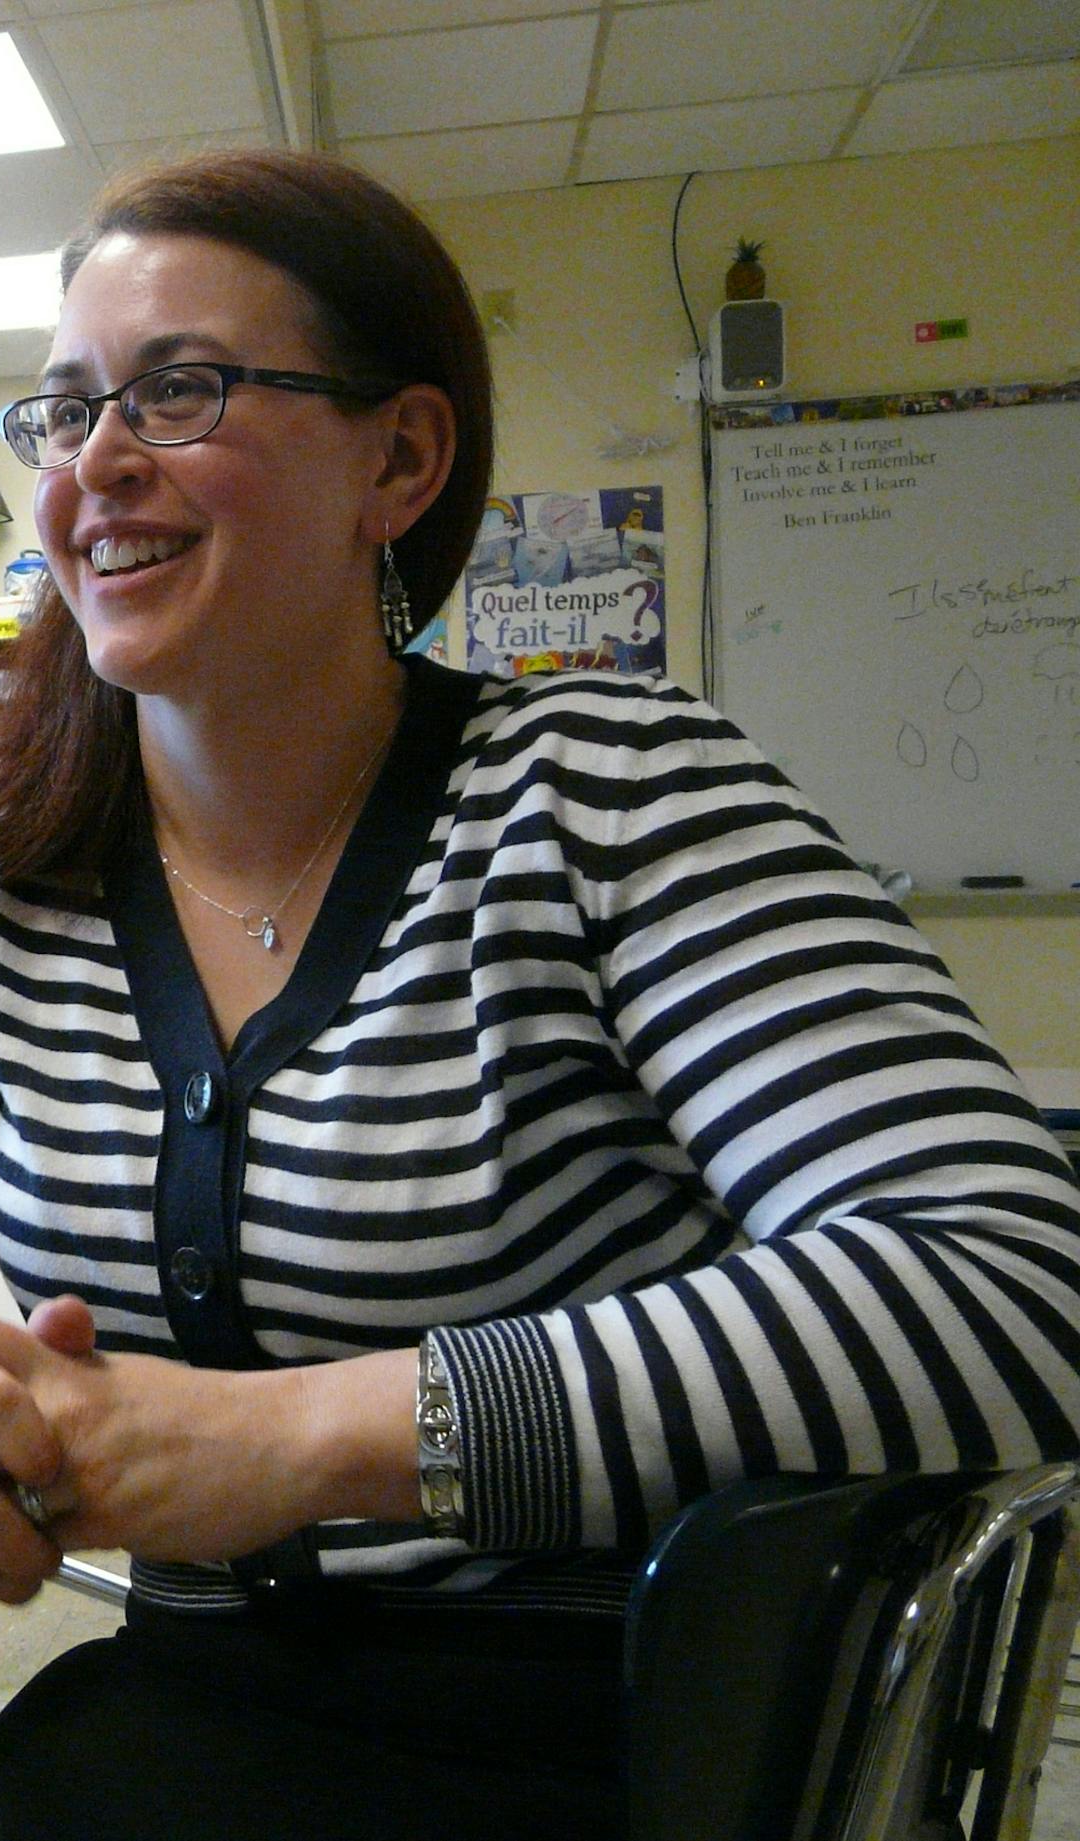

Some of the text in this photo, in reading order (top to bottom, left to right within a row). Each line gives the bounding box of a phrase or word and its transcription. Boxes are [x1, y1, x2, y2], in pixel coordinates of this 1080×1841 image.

[751, 443, 784, 459] Tell
[789, 446, 814, 456] me
[819, 440, 833, 453] &
[855, 435, 903, 450] forget
[731, 464, 781, 482] Teach
[787, 465, 812, 477] me
[817, 461, 832, 475] &
[851, 451, 937, 472] remember
[743, 485, 803, 502] Involve
[810, 483, 836, 496] me
[841, 480, 856, 493] &
[876, 475, 917, 491] learn
[784, 506, 892, 528] Ben Franklin
[482, 580, 659, 642] Quel temps ?
[496, 614, 588, 649] fait-il
